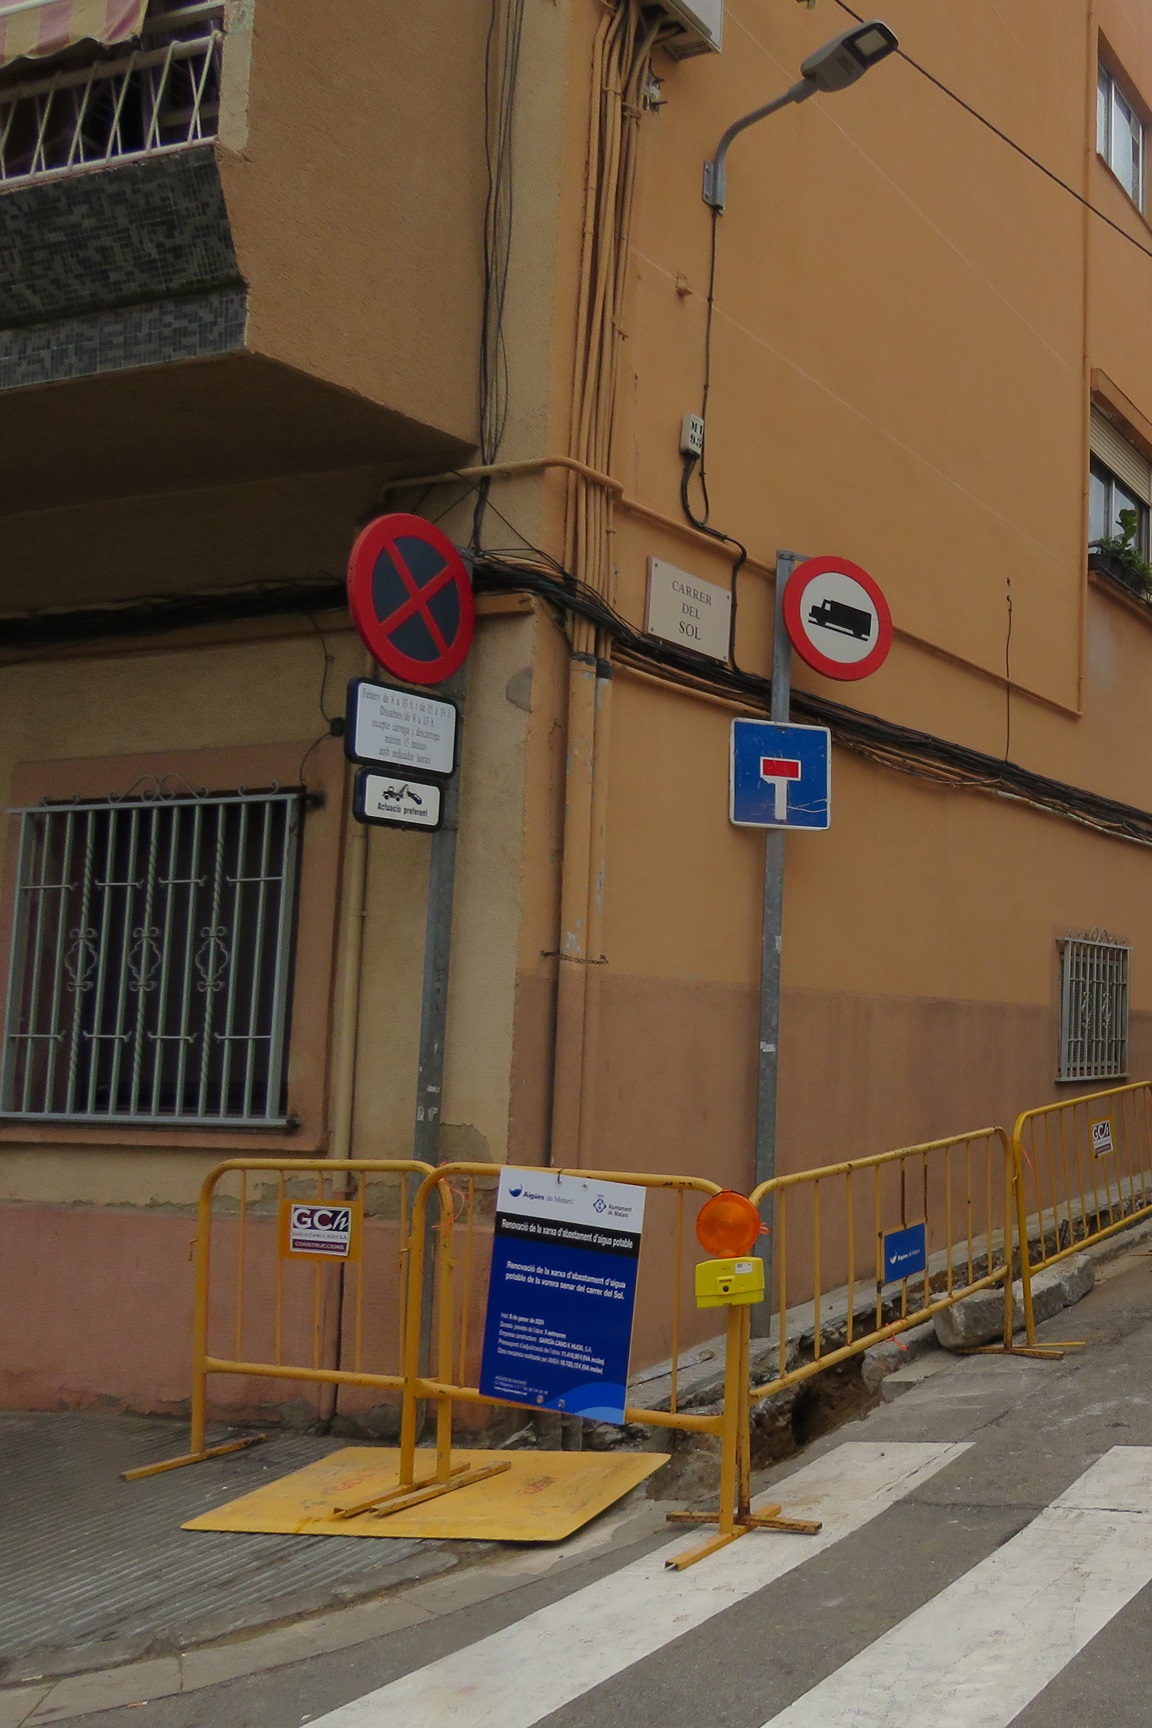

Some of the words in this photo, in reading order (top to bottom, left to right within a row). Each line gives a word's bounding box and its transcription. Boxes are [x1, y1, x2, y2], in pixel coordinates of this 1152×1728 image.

[672, 579, 711, 606] CARRER
[682, 602, 701, 620] DEL
[679, 620, 701, 641] SOL
[383, 693, 388, 703] de
[420, 703, 425, 712] de
[380, 706, 402, 719] Dissabtes
[404, 712, 410, 721] de
[403, 737, 409, 747] 15
[379, 746, 389, 756] amb
[392, 748, 414, 761] indicador
[378, 802, 401, 813] Actuació
[404, 807, 428, 818] preferent
[523, 1191, 544, 1201] Aigües
[554, 1195, 573, 1204] Mataró
[608, 1204, 632, 1213] Ajuntament
[501, 1219, 528, 1231] Renovació
[529, 1224, 536, 1232] de
[536, 1224, 542, 1233] la
[542, 1228, 556, 1236] xarxa
[557, 1228, 592, 1242] d'abastament
[592, 1233, 612, 1247] d'aigua
[612, 1237, 633, 1250] potable
[506, 1261, 535, 1272] Renovació
[536, 1266, 543, 1274] de
[544, 1267, 550, 1275] la
[550, 1270, 566, 1278] xarxa
[566, 1271, 604, 1284] d'abastament
[605, 1278, 626, 1290] d'aigua
[505, 1272, 526, 1283] potable
[541, 1279, 559, 1288] vorera
[576, 1284, 585, 1292] del
[586, 1287, 603, 1296] carrer
[604, 1289, 613, 1297] del
[613, 1290, 624, 1299] Sol.
